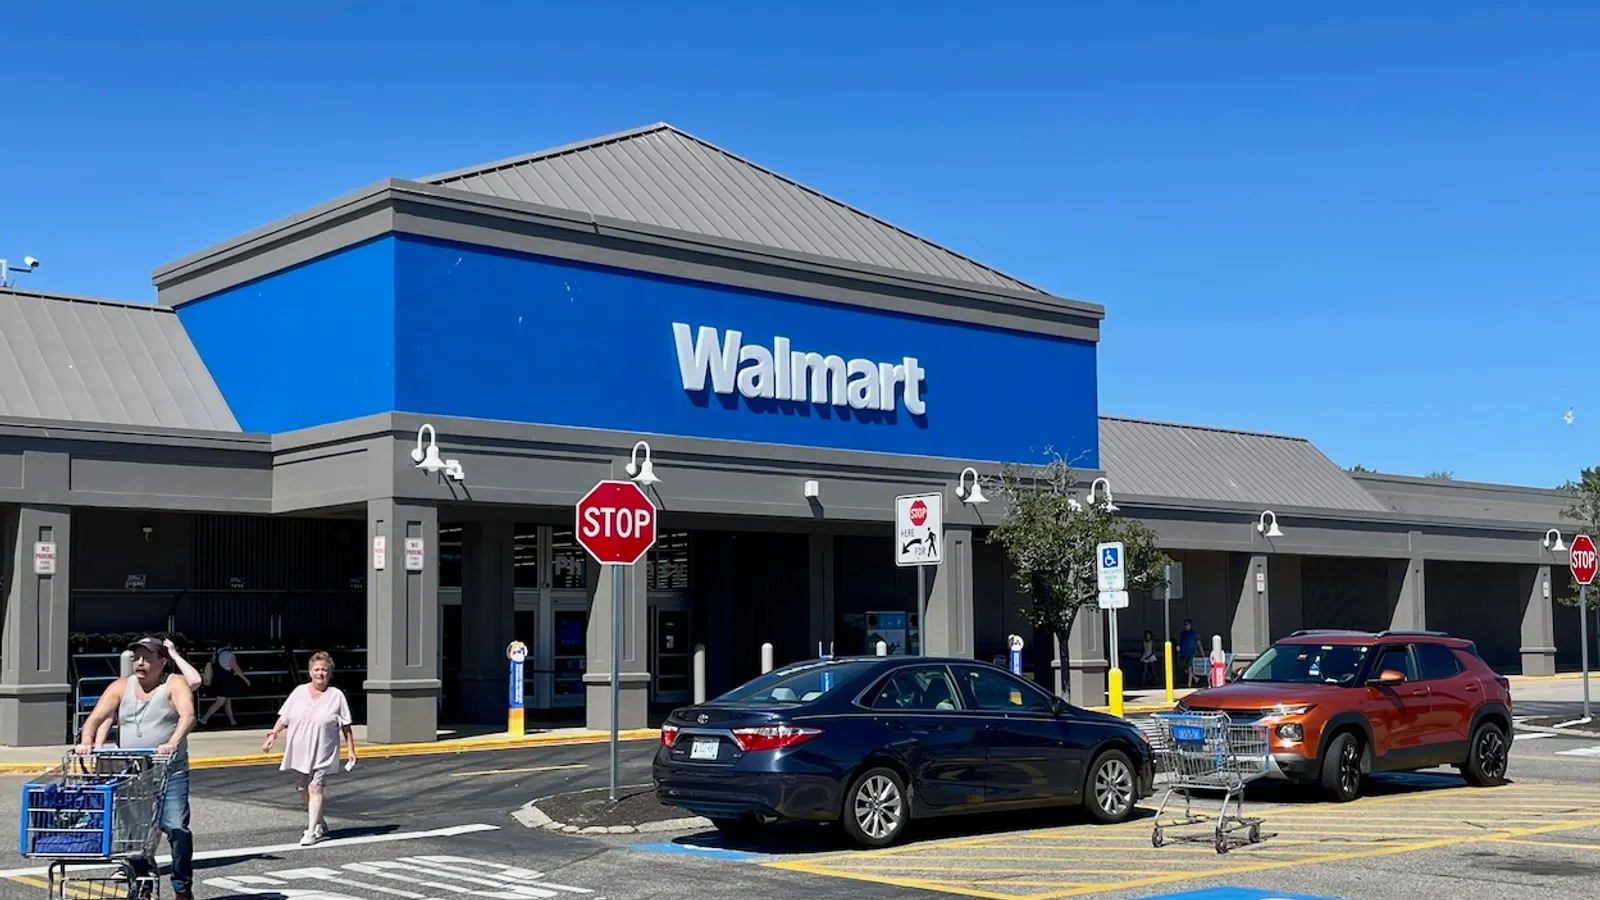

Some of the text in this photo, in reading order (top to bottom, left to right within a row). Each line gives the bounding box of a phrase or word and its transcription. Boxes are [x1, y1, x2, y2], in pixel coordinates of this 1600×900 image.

[672, 322, 926, 415] Walmart
[583, 506, 651, 538] STOP
[910, 507, 927, 519] STOP
[901, 529, 915, 538] HERE
[914, 546, 926, 556] FOR
[1572, 550, 1595, 569] STOP
[202, 855, 595, 900] STOP
